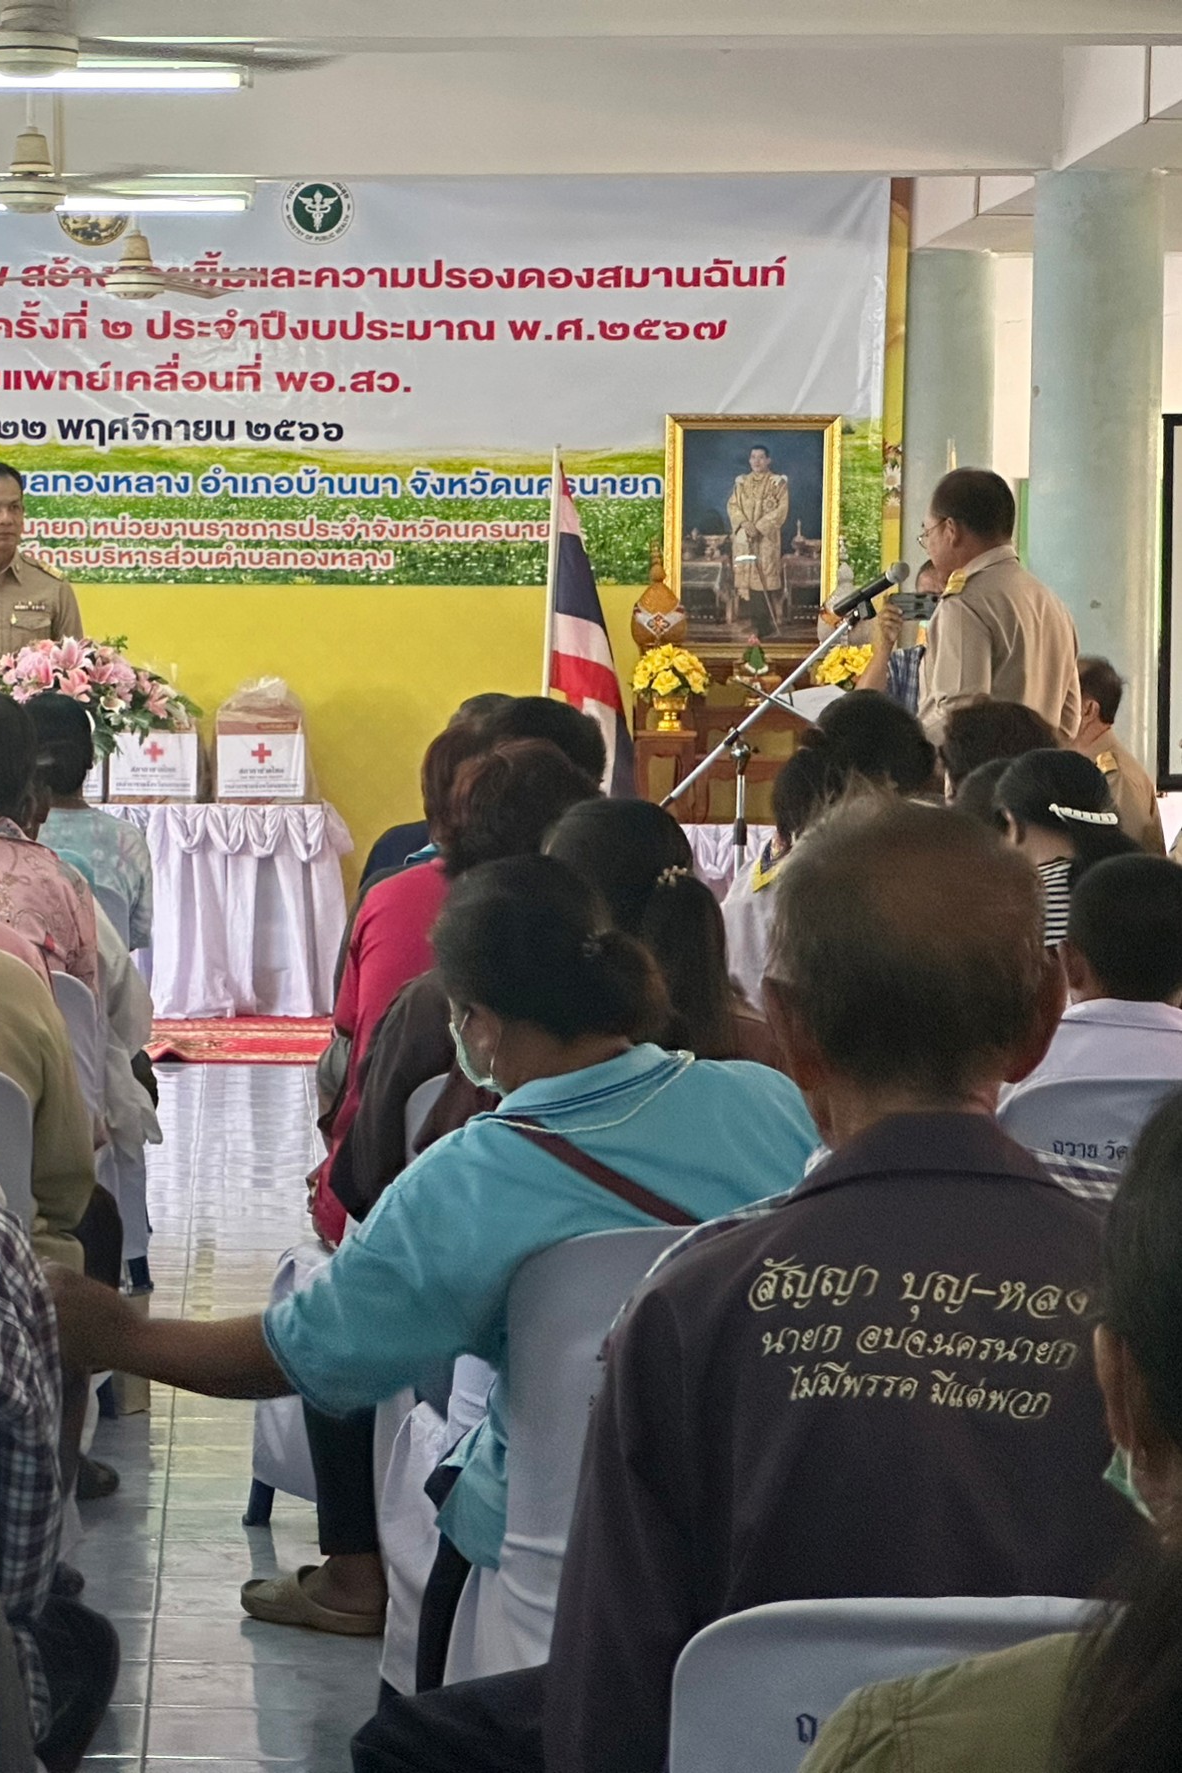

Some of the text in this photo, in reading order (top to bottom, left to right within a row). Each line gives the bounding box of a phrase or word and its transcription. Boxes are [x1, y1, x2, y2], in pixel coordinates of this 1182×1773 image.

[101, 319, 133, 340] ๒
[146, 308, 496, 341] ประจำปีงบประมาณ
[508, 318, 728, 341] พ.ศ.๒๕๖๗
[275, 369, 413, 393] พอ.สว.
[57, 412, 235, 447] พฤศจิกายน
[245, 419, 344, 442] ๒๕๖๖
[201, 468, 398, 495] อำเภอบ้านนา
[94, 517, 550, 539] หน่วยงานราชการประจำจังหวัดนครนาย
[748, 1255, 879, 1311] สัญญา
[762, 1325, 843, 1357] นายก
[788, 1360, 1053, 1420] ไม่มีพรรค มีแต่พวก
